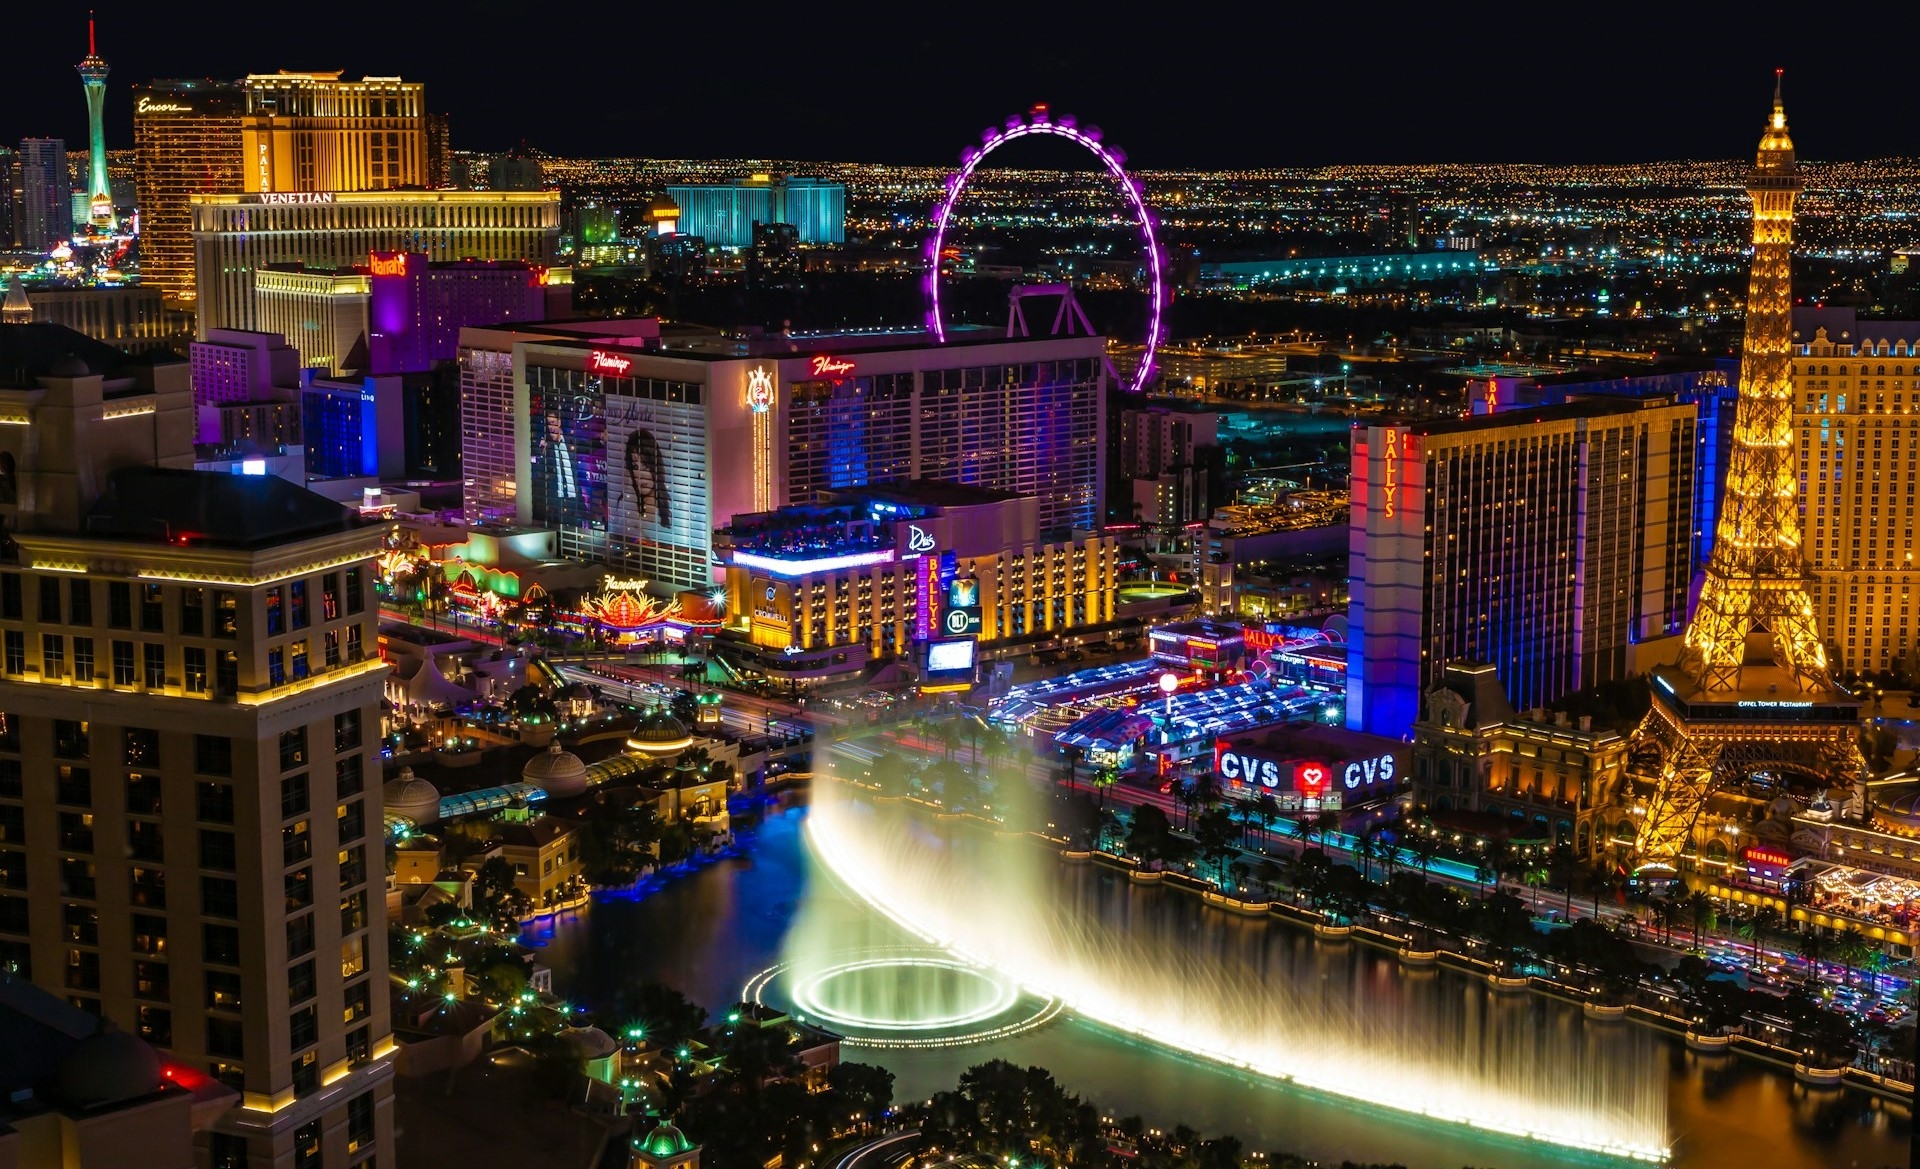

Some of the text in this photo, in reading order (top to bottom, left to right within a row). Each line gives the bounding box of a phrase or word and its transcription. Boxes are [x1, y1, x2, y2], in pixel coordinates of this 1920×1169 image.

[138, 97, 192, 113] Encore
[260, 192, 333, 204] VENETIAN
[370, 254, 406, 277] Harrah's
[592, 351, 631, 374] Flamingo
[812, 356, 855, 376] Flamingo
[1383, 429, 1398, 518] BALLYS
[604, 574, 649, 595] Flamingo
[928, 558, 939, 630] BALLYS
[951, 614, 964, 629] BLT
[1243, 628, 1285, 647] BALLY'S
[1738, 700, 1758, 708] EIFFEL
[1221, 752, 1279, 788] CVS
[1344, 754, 1394, 789] CVS
[1747, 850, 1789, 866] BEER PARK
